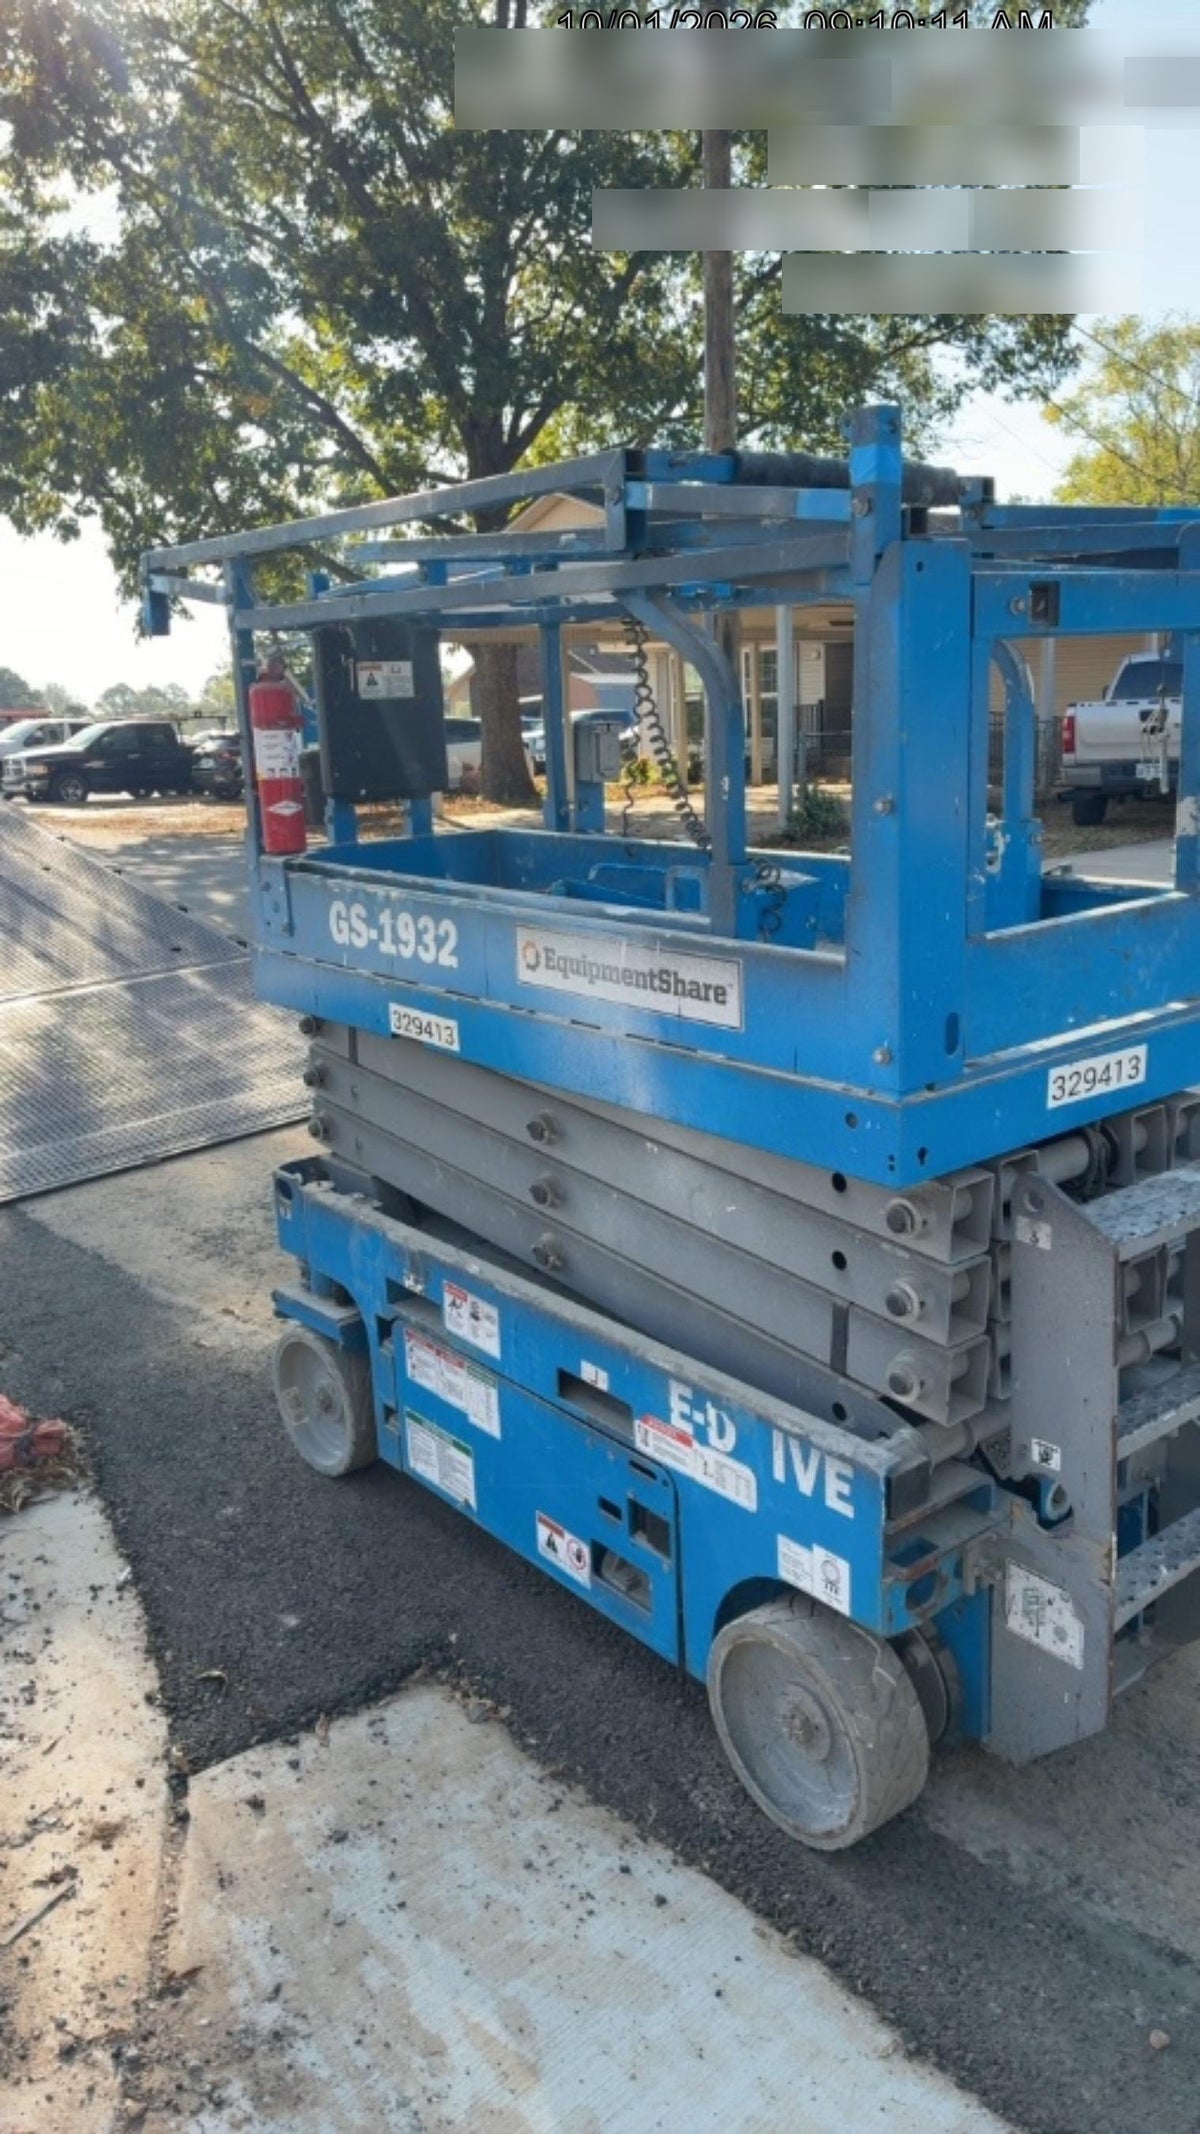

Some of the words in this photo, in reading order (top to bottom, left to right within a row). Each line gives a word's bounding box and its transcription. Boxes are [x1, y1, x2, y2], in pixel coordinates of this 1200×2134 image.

[329, 901, 459, 968] GS-1932
[543, 947, 727, 1005] EquipmentShare
[392, 1009, 456, 1046] 329413
[1052, 1054, 1141, 1101] 329413
